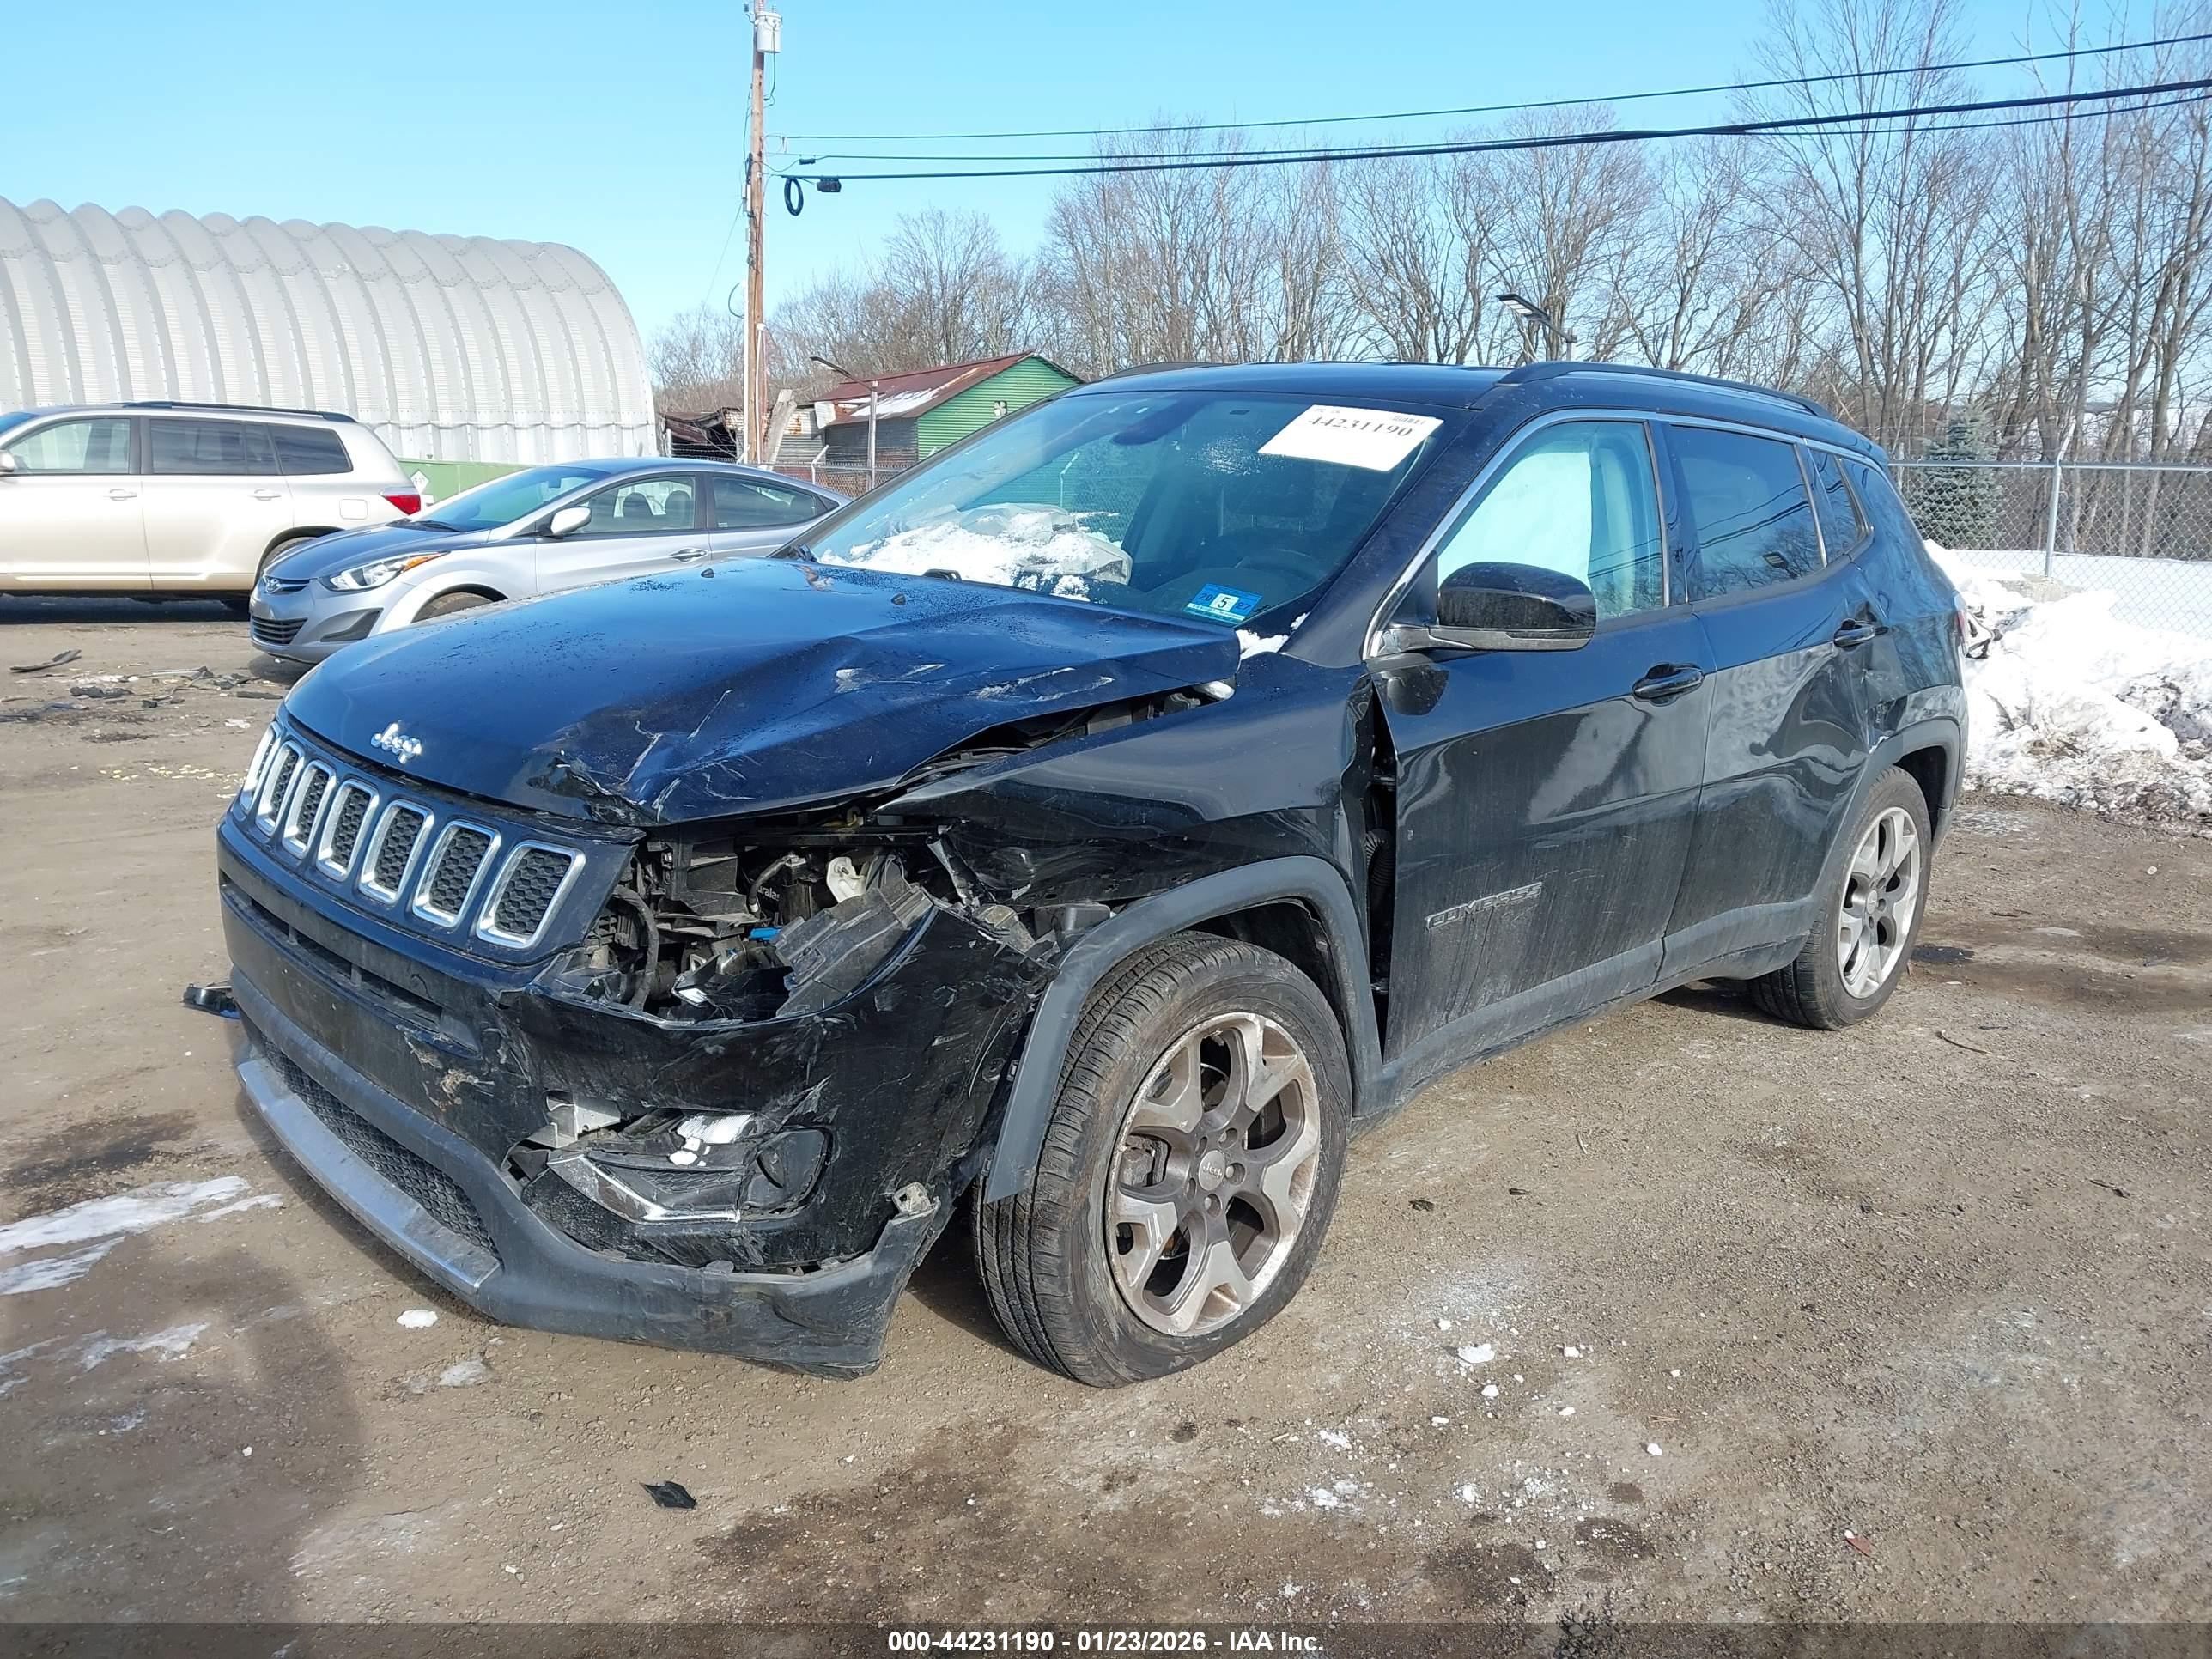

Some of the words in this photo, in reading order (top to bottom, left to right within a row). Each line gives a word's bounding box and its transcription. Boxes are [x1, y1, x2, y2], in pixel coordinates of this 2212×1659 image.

[1307, 416, 1413, 436] 44231190
[1217, 597, 1231, 608] 5
[1202, 1162, 1223, 1179] Jeep
